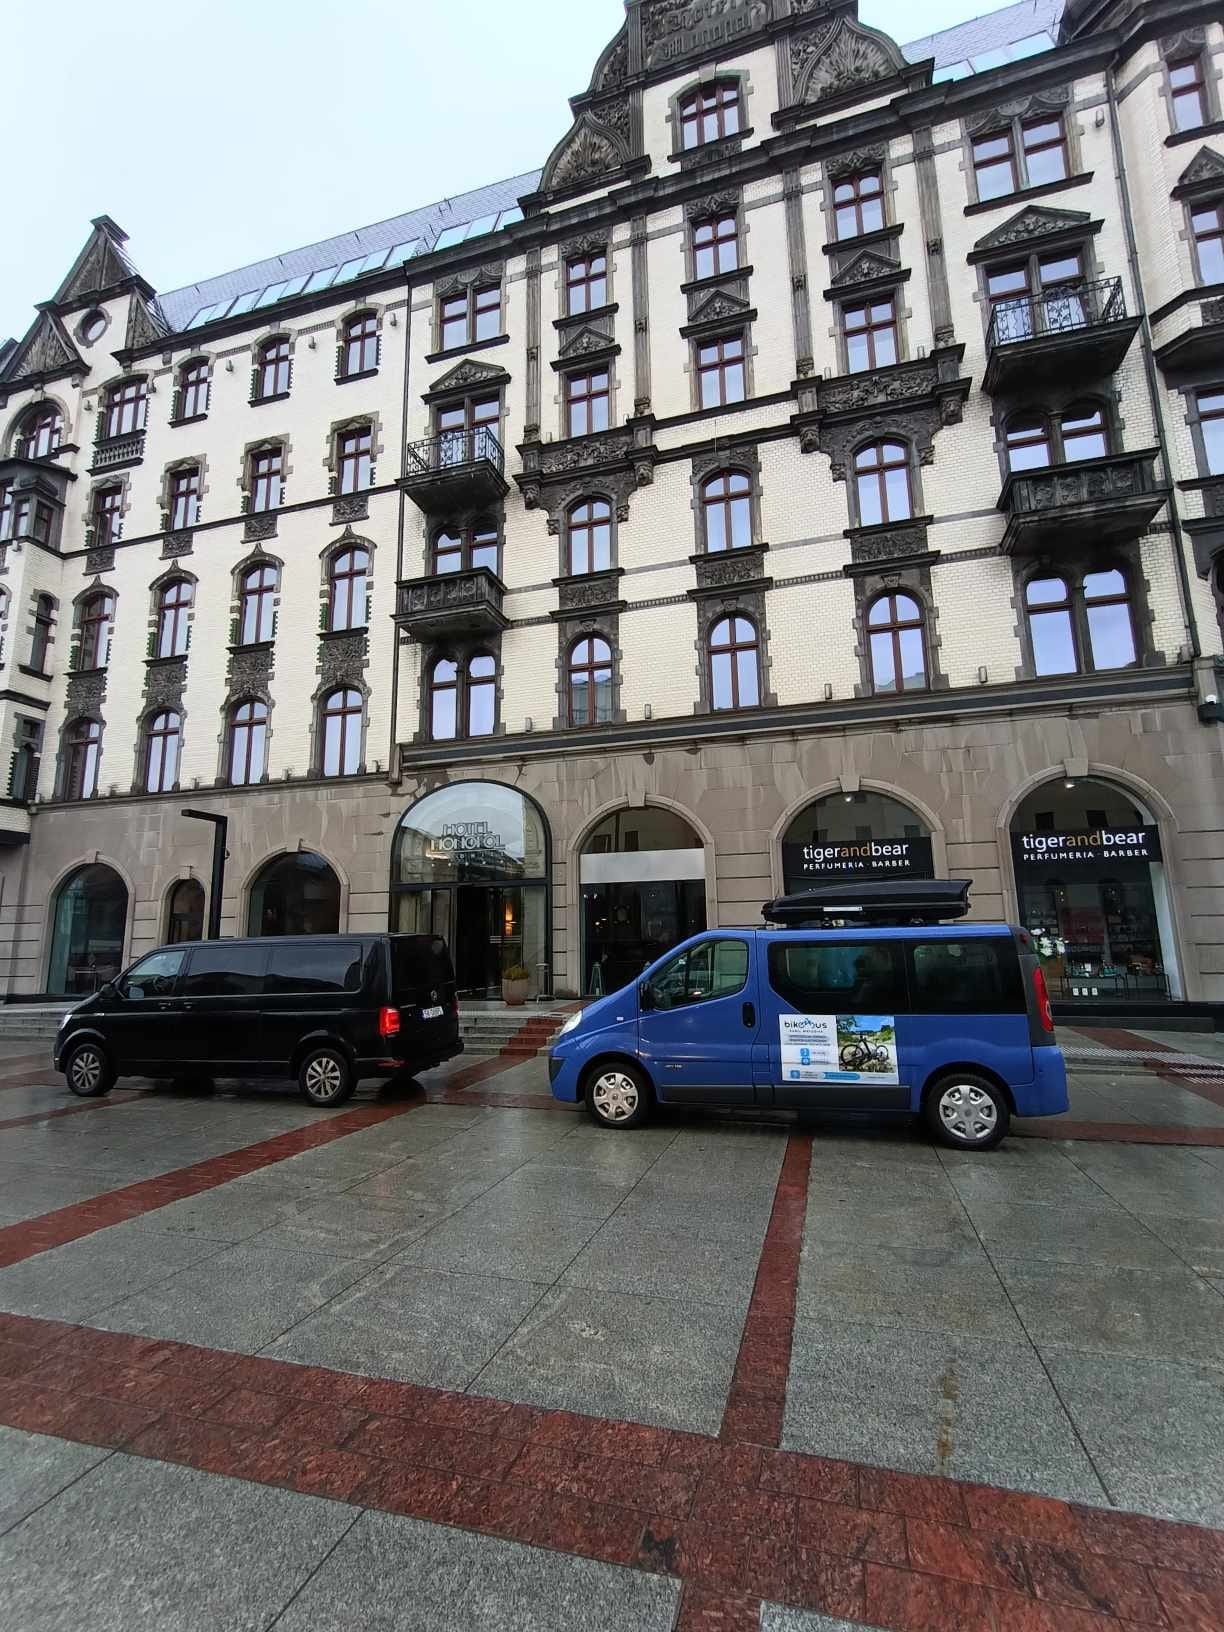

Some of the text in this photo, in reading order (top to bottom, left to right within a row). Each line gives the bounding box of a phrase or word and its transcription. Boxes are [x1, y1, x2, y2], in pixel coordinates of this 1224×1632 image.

[442, 821, 493, 837] HOTEL
[431, 834, 506, 851] MONOPOL
[1022, 830, 1146, 852] tigerandbear
[802, 841, 909, 862] tigerandbear
[1023, 851, 1094, 861] PERFUMERIA
[1103, 849, 1149, 858] BARBER
[803, 861, 864, 871] PERFUMERIA
[871, 859, 911, 869] BARBER
